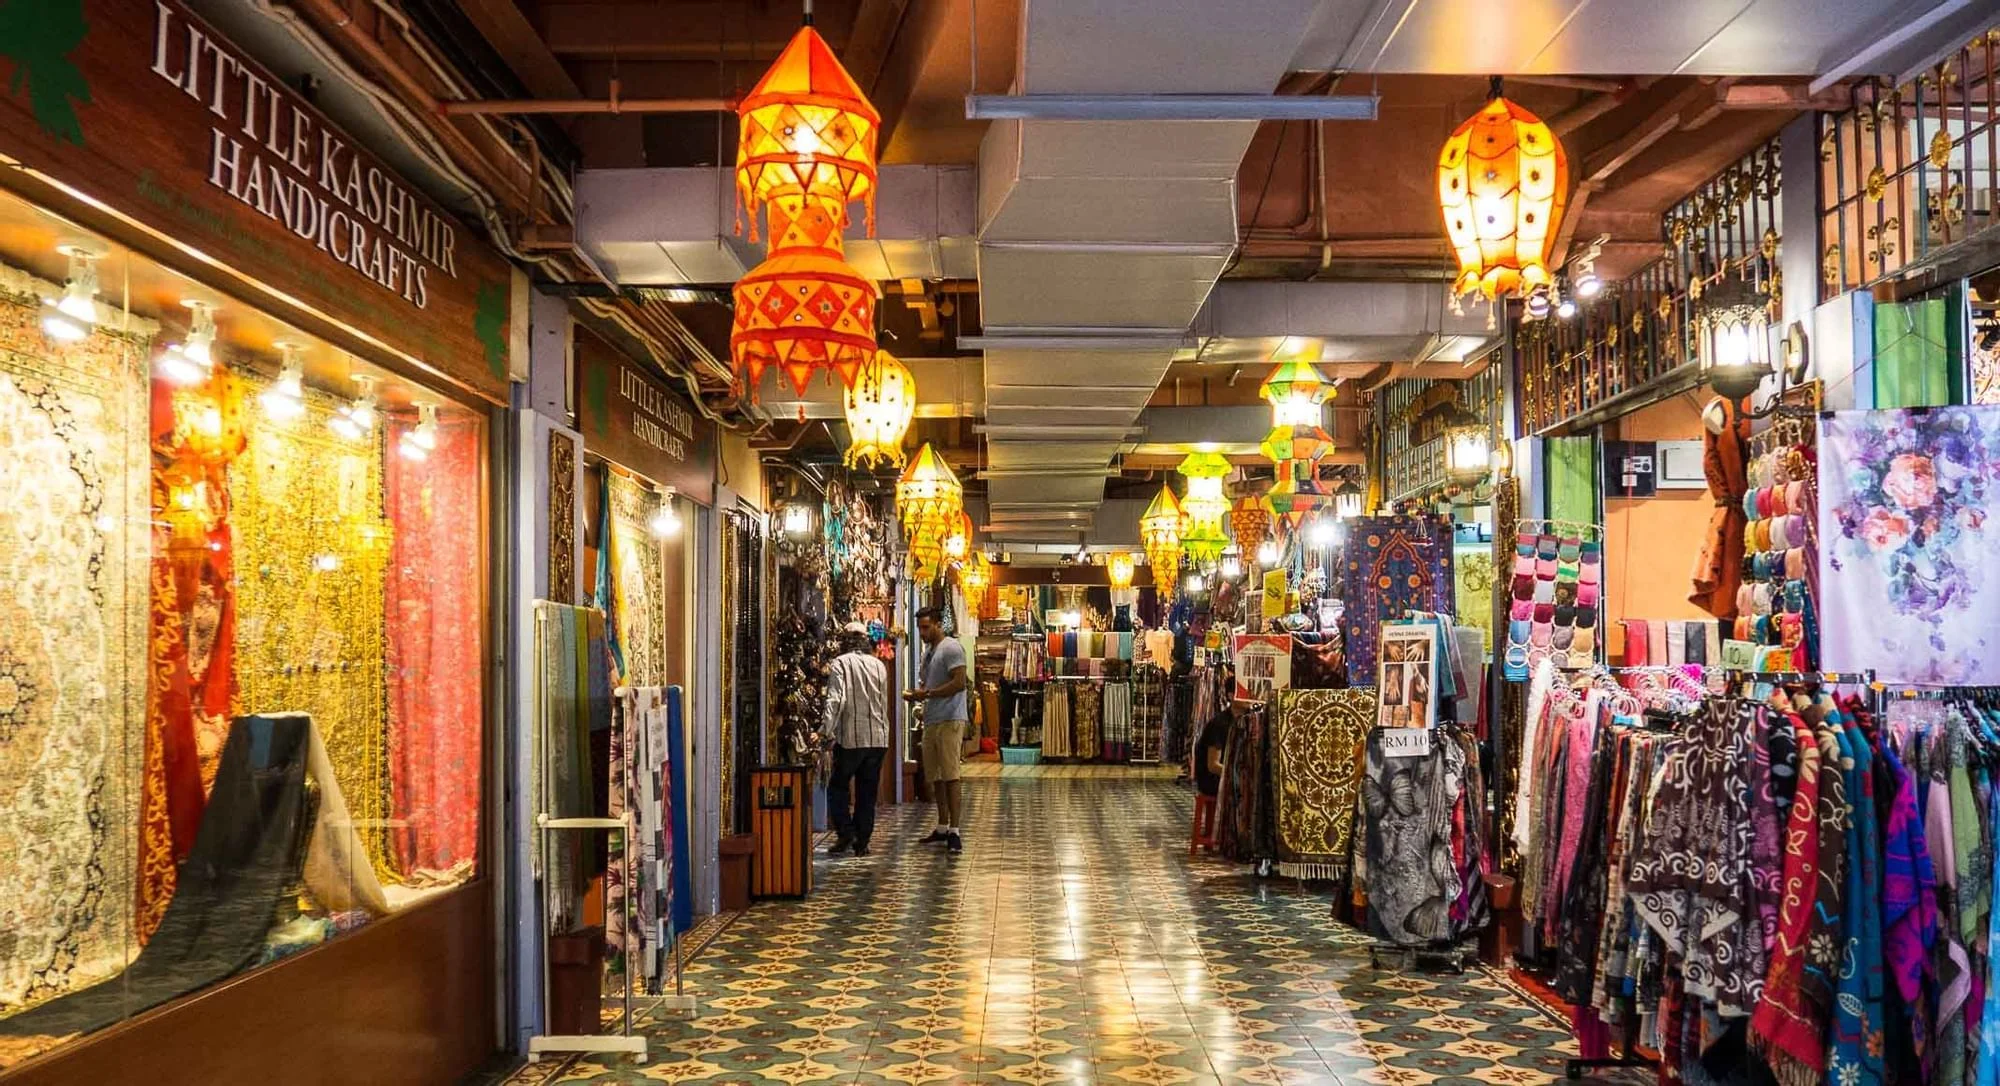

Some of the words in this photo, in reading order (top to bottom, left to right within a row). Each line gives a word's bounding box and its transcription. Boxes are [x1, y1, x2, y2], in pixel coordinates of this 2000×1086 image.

[151, 0, 312, 177] LITTLE
[318, 128, 457, 279] KASHMIR
[209, 127, 427, 309] HANDICRAFTS
[621, 366, 655, 416] LITTLE
[656, 391, 693, 441] KASHMIR
[633, 411, 685, 462] HANDICRAFTS
[1385, 735, 1407, 748] RM
[1413, 735, 1428, 746] 10
